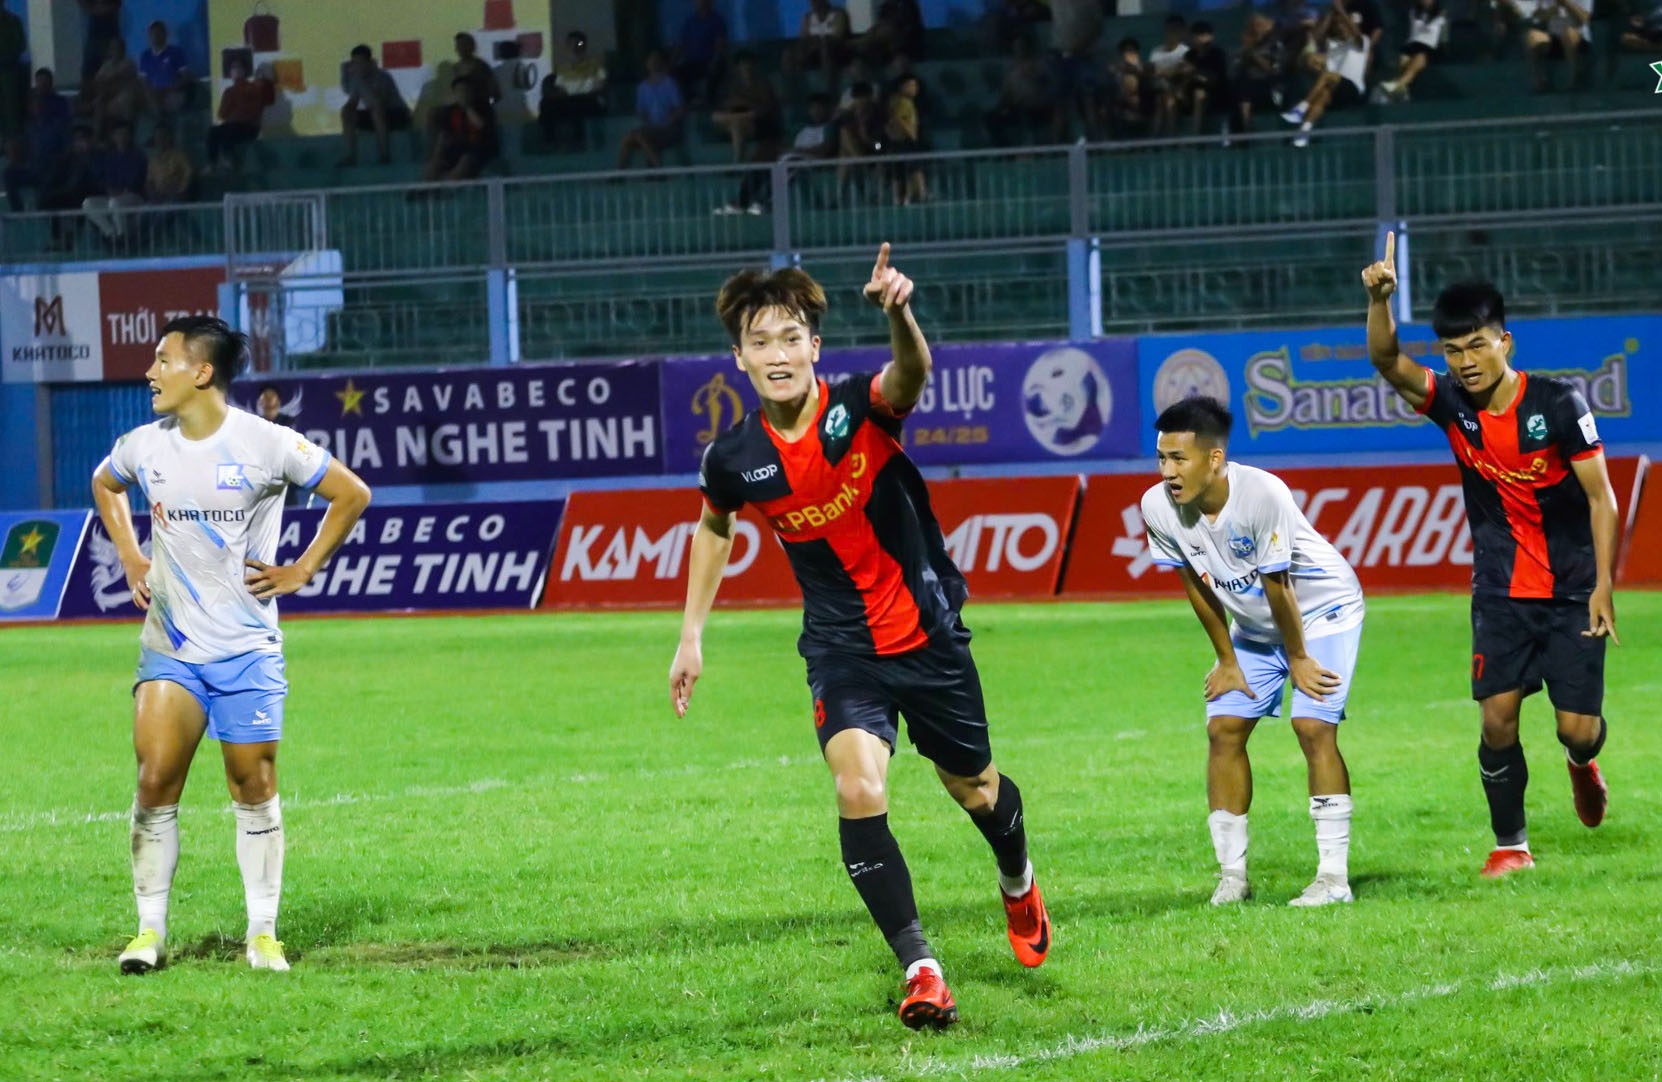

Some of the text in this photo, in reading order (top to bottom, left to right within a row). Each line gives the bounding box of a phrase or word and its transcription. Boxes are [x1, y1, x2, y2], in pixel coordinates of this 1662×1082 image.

[12, 344, 91, 363] KHATOCO
[374, 377, 611, 414] SAVABECO
[396, 421, 529, 467] NGHE
[538, 415, 656, 461] TINH
[740, 464, 778, 482] VLOOP
[168, 509, 245, 522] KHATOCO
[278, 514, 505, 548] AABECO
[559, 520, 761, 582] KAMIO
[943, 513, 1059, 572] MITO
[277, 550, 539, 598] GHE TINH
[1213, 568, 1259, 592] KHATO
[814, 699, 826, 728] 8
